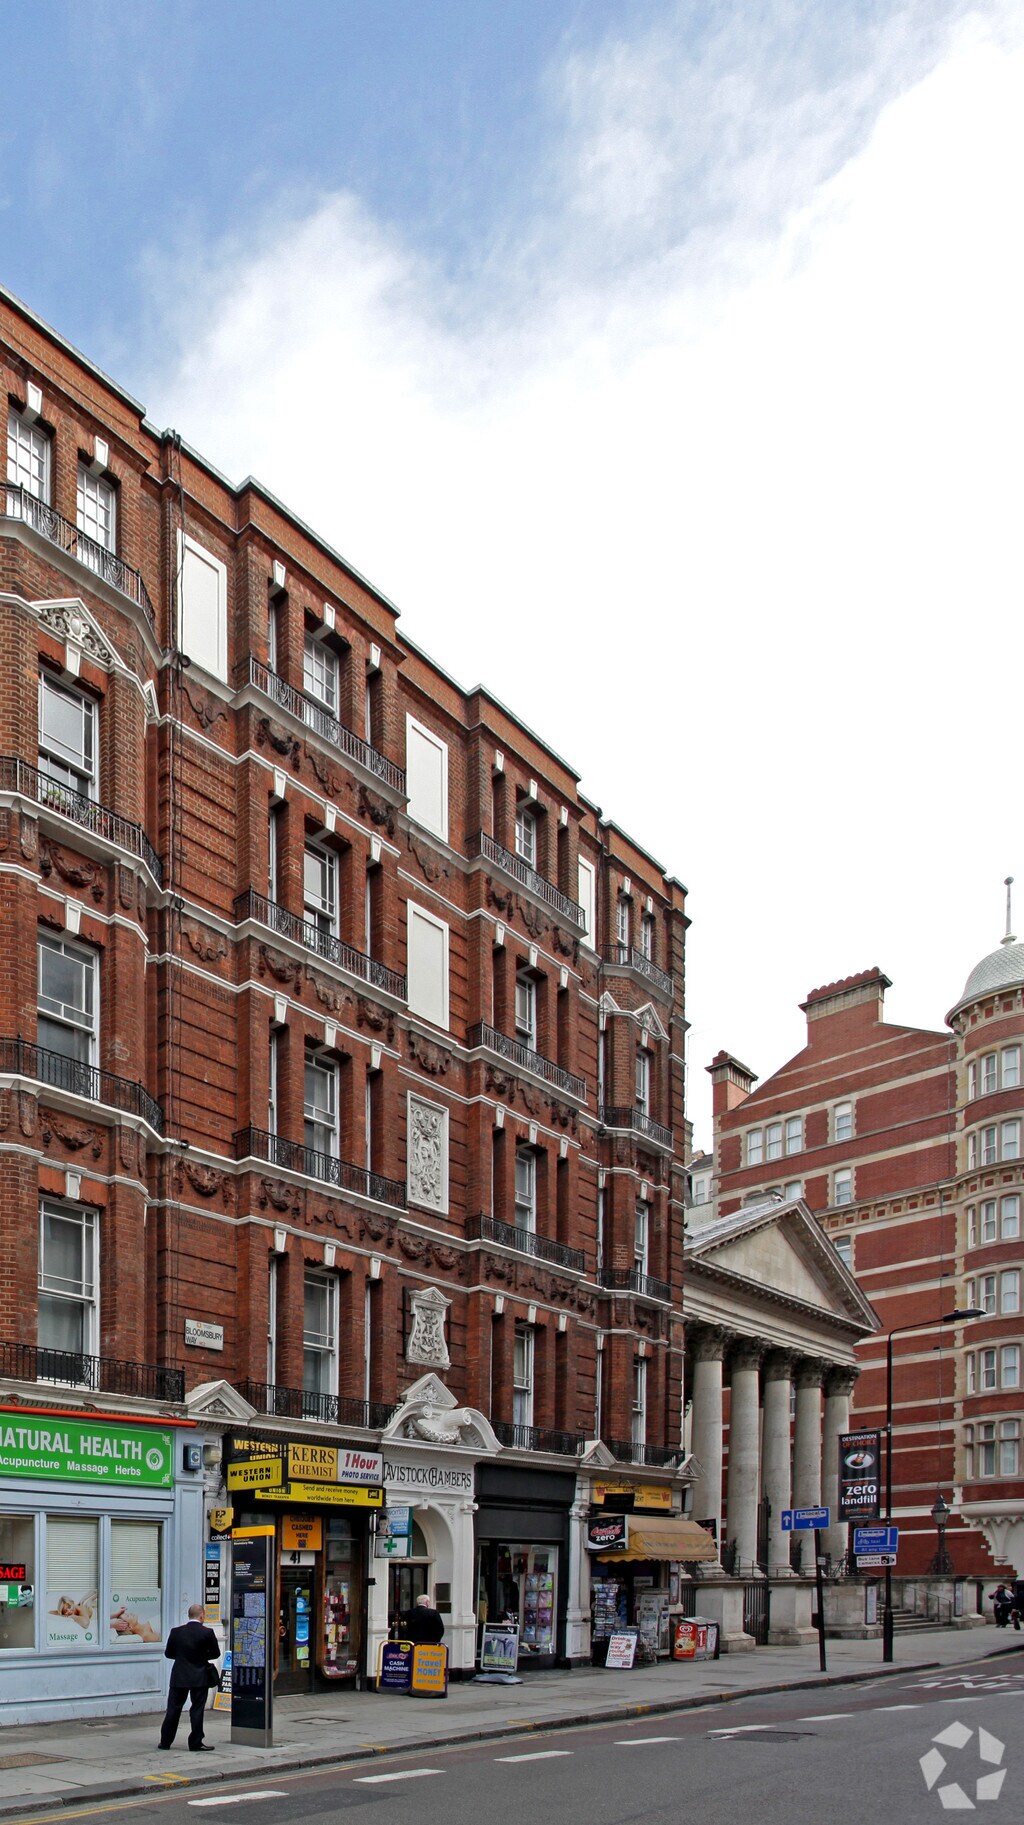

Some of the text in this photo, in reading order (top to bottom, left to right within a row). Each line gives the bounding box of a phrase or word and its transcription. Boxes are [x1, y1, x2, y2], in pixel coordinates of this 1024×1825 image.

[186, 1327, 223, 1341] BLOOMSBURY
[186, 1336, 197, 1344] WAY
[842, 1433, 877, 1442] DESTINATION
[853, 1439, 876, 1447] CHOICE
[80, 1435, 142, 1460] HEALTH
[234, 1440, 278, 1453] WESTERN
[292, 1446, 335, 1464] KERRS
[345, 1453, 378, 1470] 1 Hour
[67, 1461, 108, 1475] Massage
[115, 1465, 141, 1476] Herbs
[230, 1467, 271, 1477] WESTERN
[292, 1464, 333, 1477] CHEMIST
[243, 1474, 271, 1482] UNION
[360, 1473, 380, 1481] SERVICE
[383, 1461, 472, 1490] TAVISTOCK CHAMBERS
[847, 1485, 877, 1496] zero
[841, 1495, 877, 1506] landfill
[289, 1551, 301, 1564] 41
[126, 1595, 158, 1603] Acupuncture
[49, 1633, 78, 1641] Massage
[418, 1658, 442, 1666] Travel
[417, 1668, 441, 1676] MONEY
